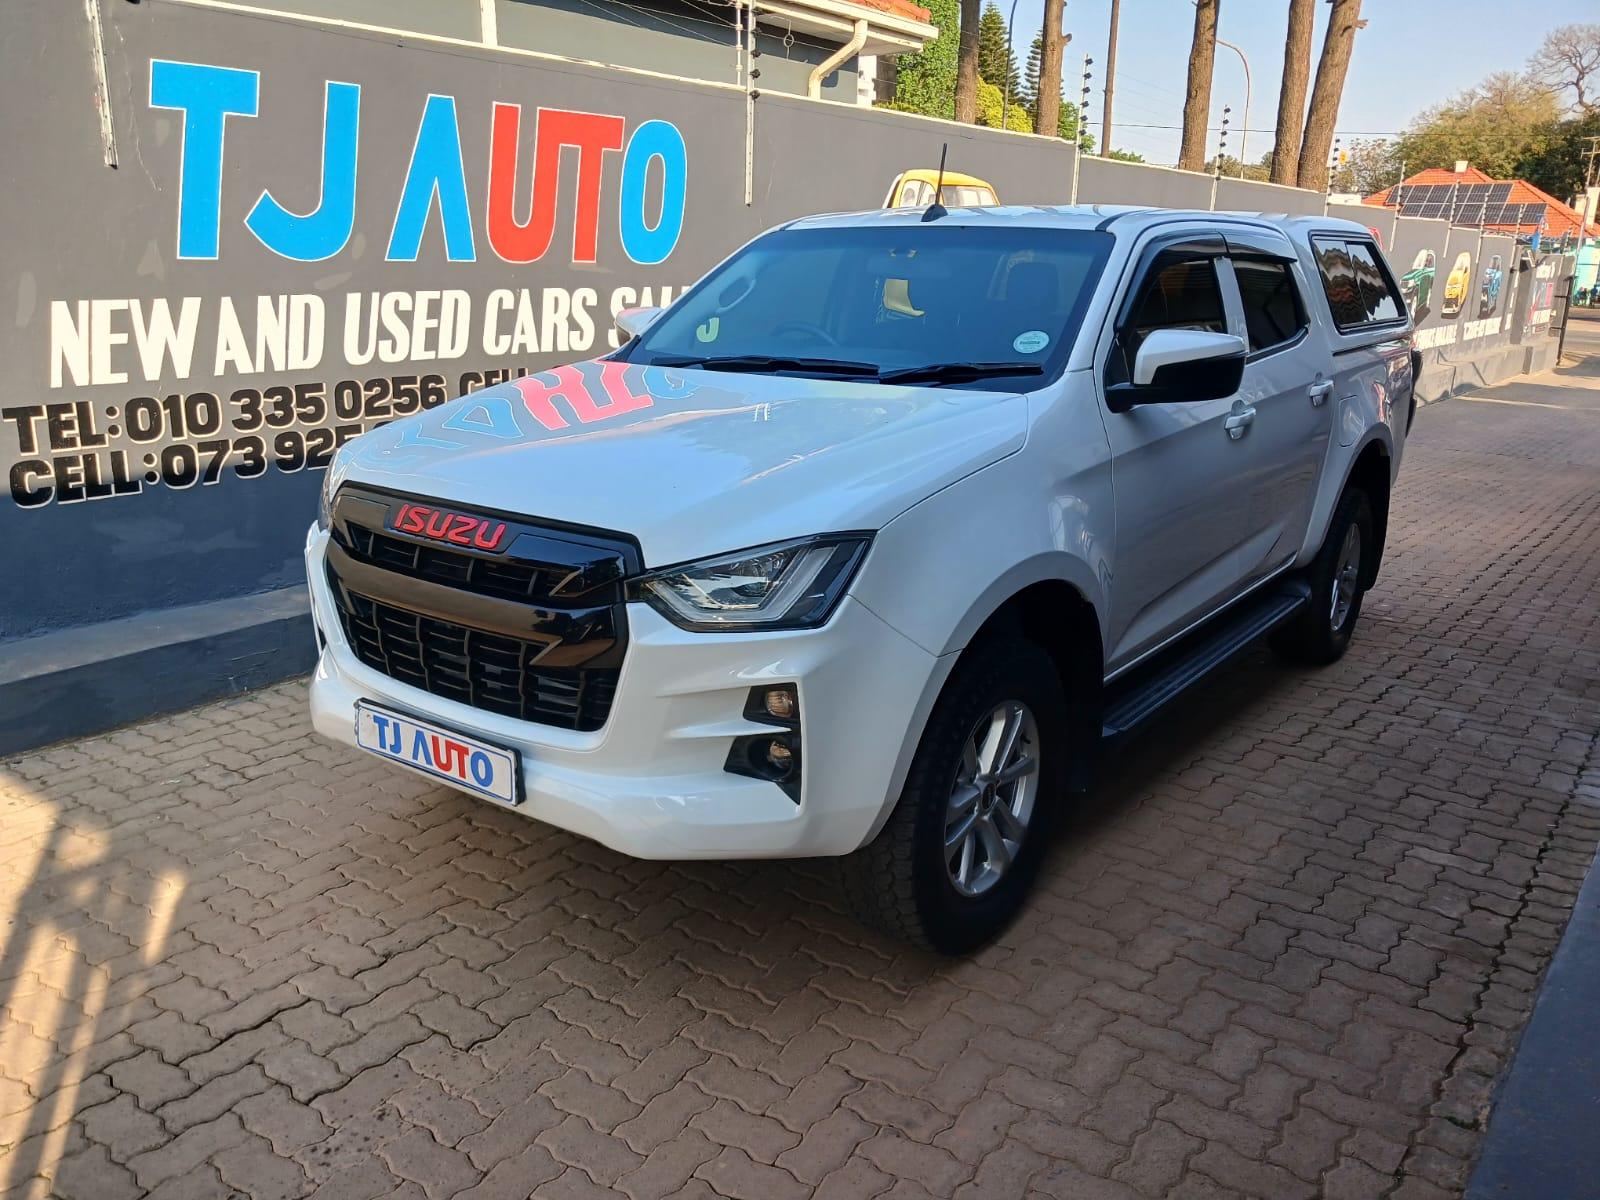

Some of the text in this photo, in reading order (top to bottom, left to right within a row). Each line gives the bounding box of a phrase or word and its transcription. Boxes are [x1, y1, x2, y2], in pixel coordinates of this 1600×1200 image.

[149, 59, 688, 265] TJ AUTO
[50, 298, 201, 387] NEW
[213, 293, 325, 379] AND
[343, 290, 468, 366] USED
[482, 288, 596, 356] CARS
[229, 381, 327, 433] 335
[334, 373, 448, 422] 0256
[394, 503, 506, 550] ISUZU
[373, 714, 494, 788] TJ AUTO
